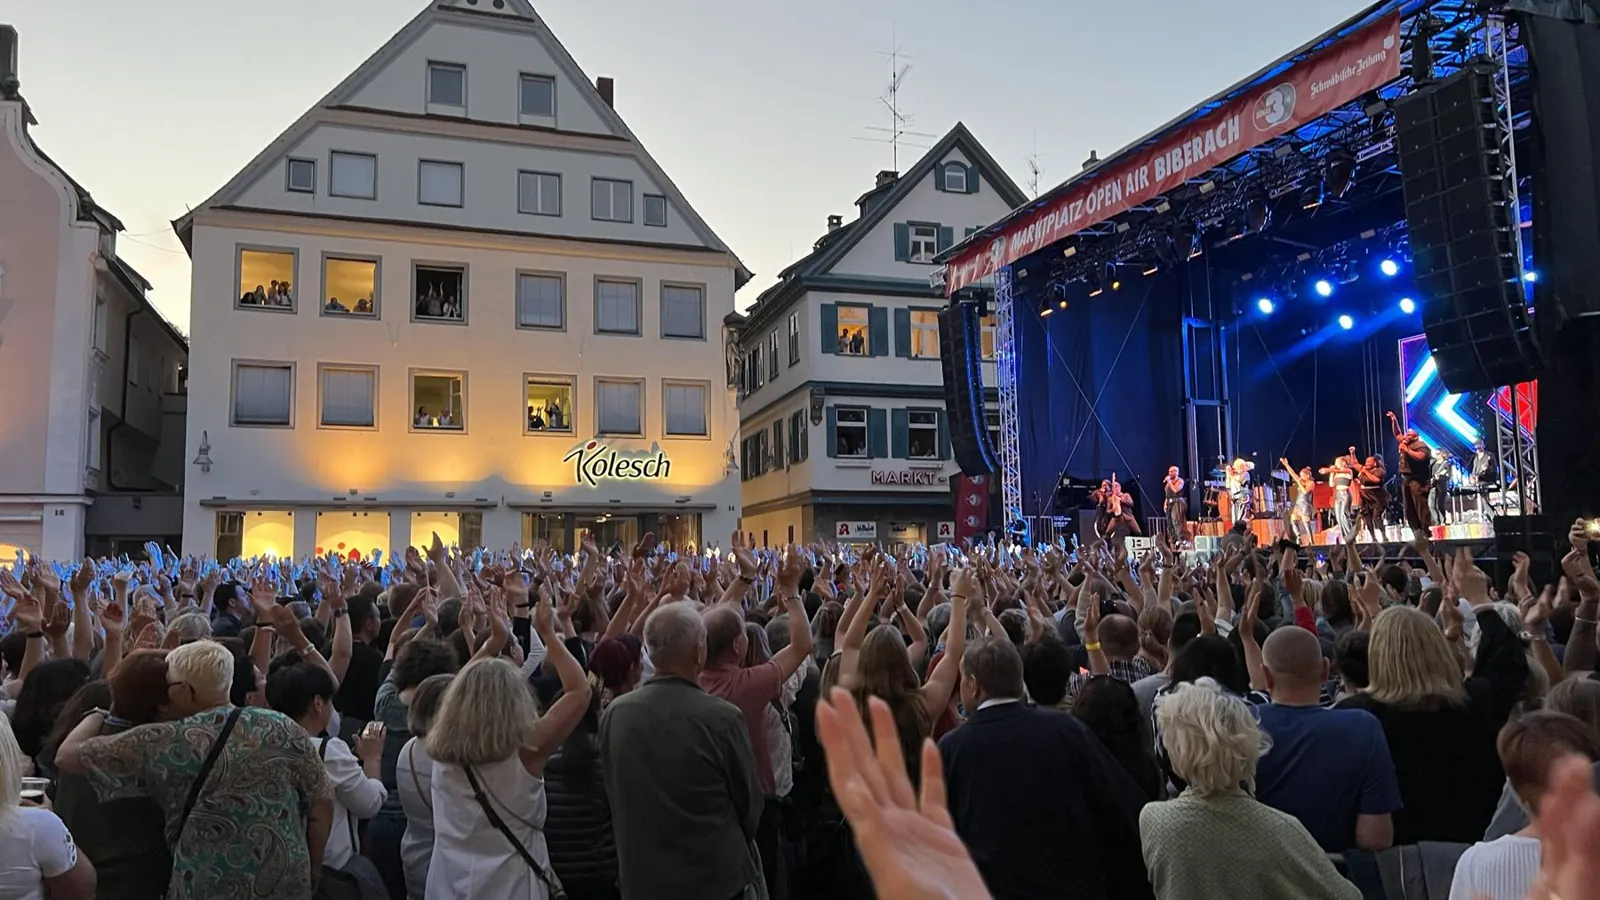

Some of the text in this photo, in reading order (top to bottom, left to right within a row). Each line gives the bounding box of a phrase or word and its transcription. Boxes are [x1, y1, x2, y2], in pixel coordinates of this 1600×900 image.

[1011, 115, 1240, 252] MARKTPLATZ OPEN AIR BIBERACH
[563, 441, 671, 486] Kolesch
[871, 470, 935, 485] MARKT
